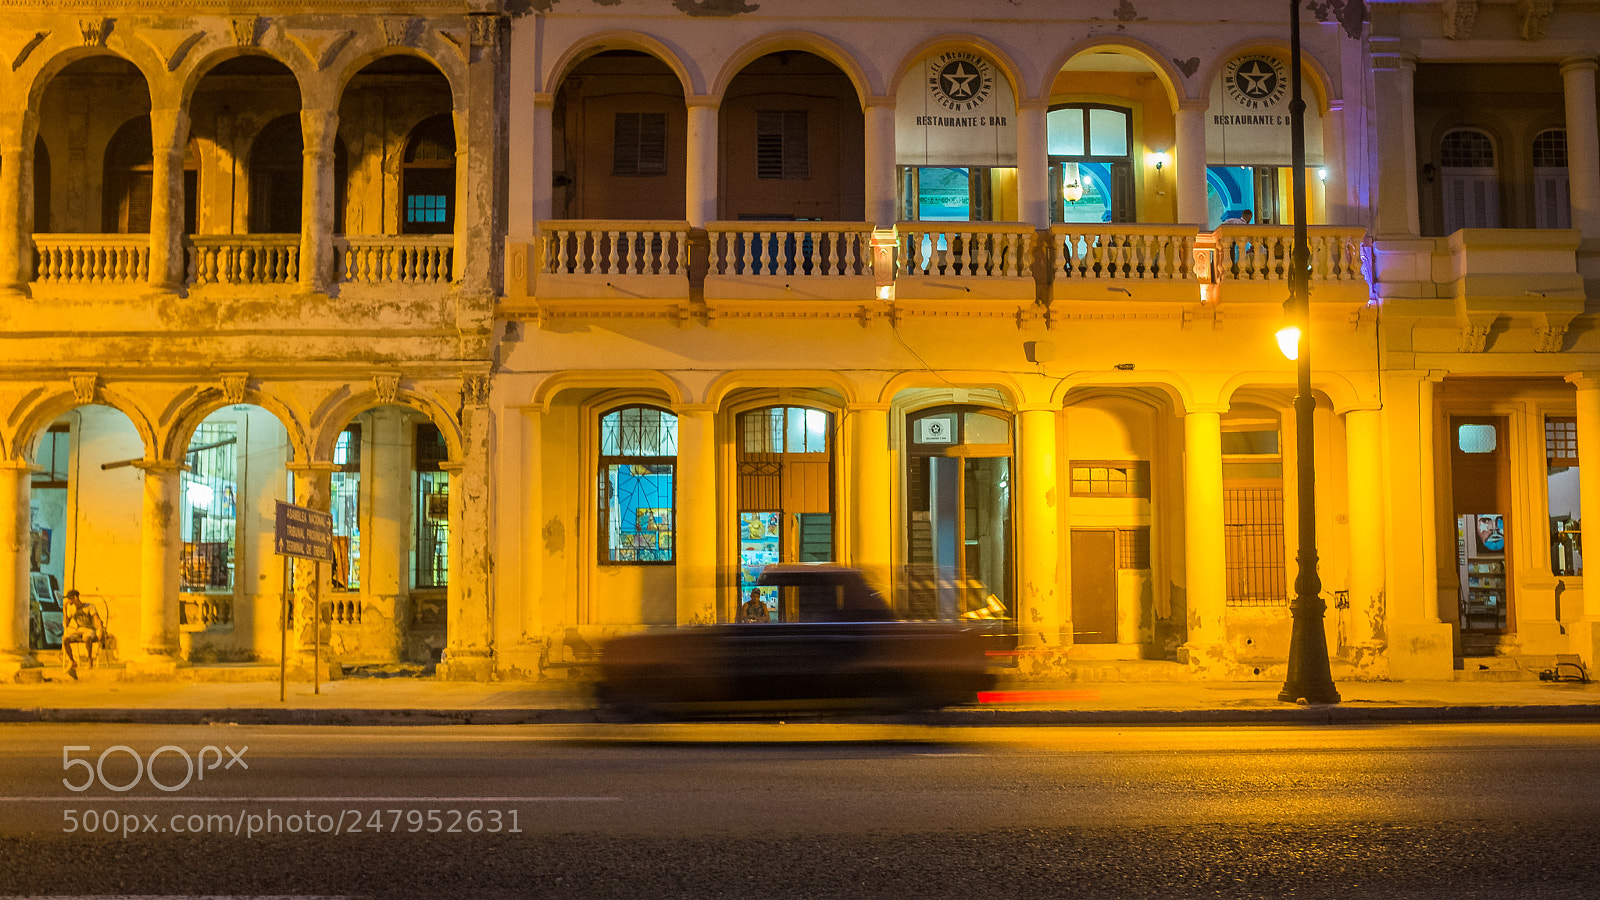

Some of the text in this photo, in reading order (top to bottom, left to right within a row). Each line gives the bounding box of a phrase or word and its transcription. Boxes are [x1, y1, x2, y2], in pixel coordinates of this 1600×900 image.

[930, 62, 941, 72] EL
[1226, 61, 1238, 71] EL
[966, 77, 993, 111] HABANA
[1263, 77, 1288, 108] HABANA
[916, 115, 978, 127] RESTAURANTE
[989, 116, 1007, 127] BAR
[1213, 115, 1275, 125] RESTAURANTE
